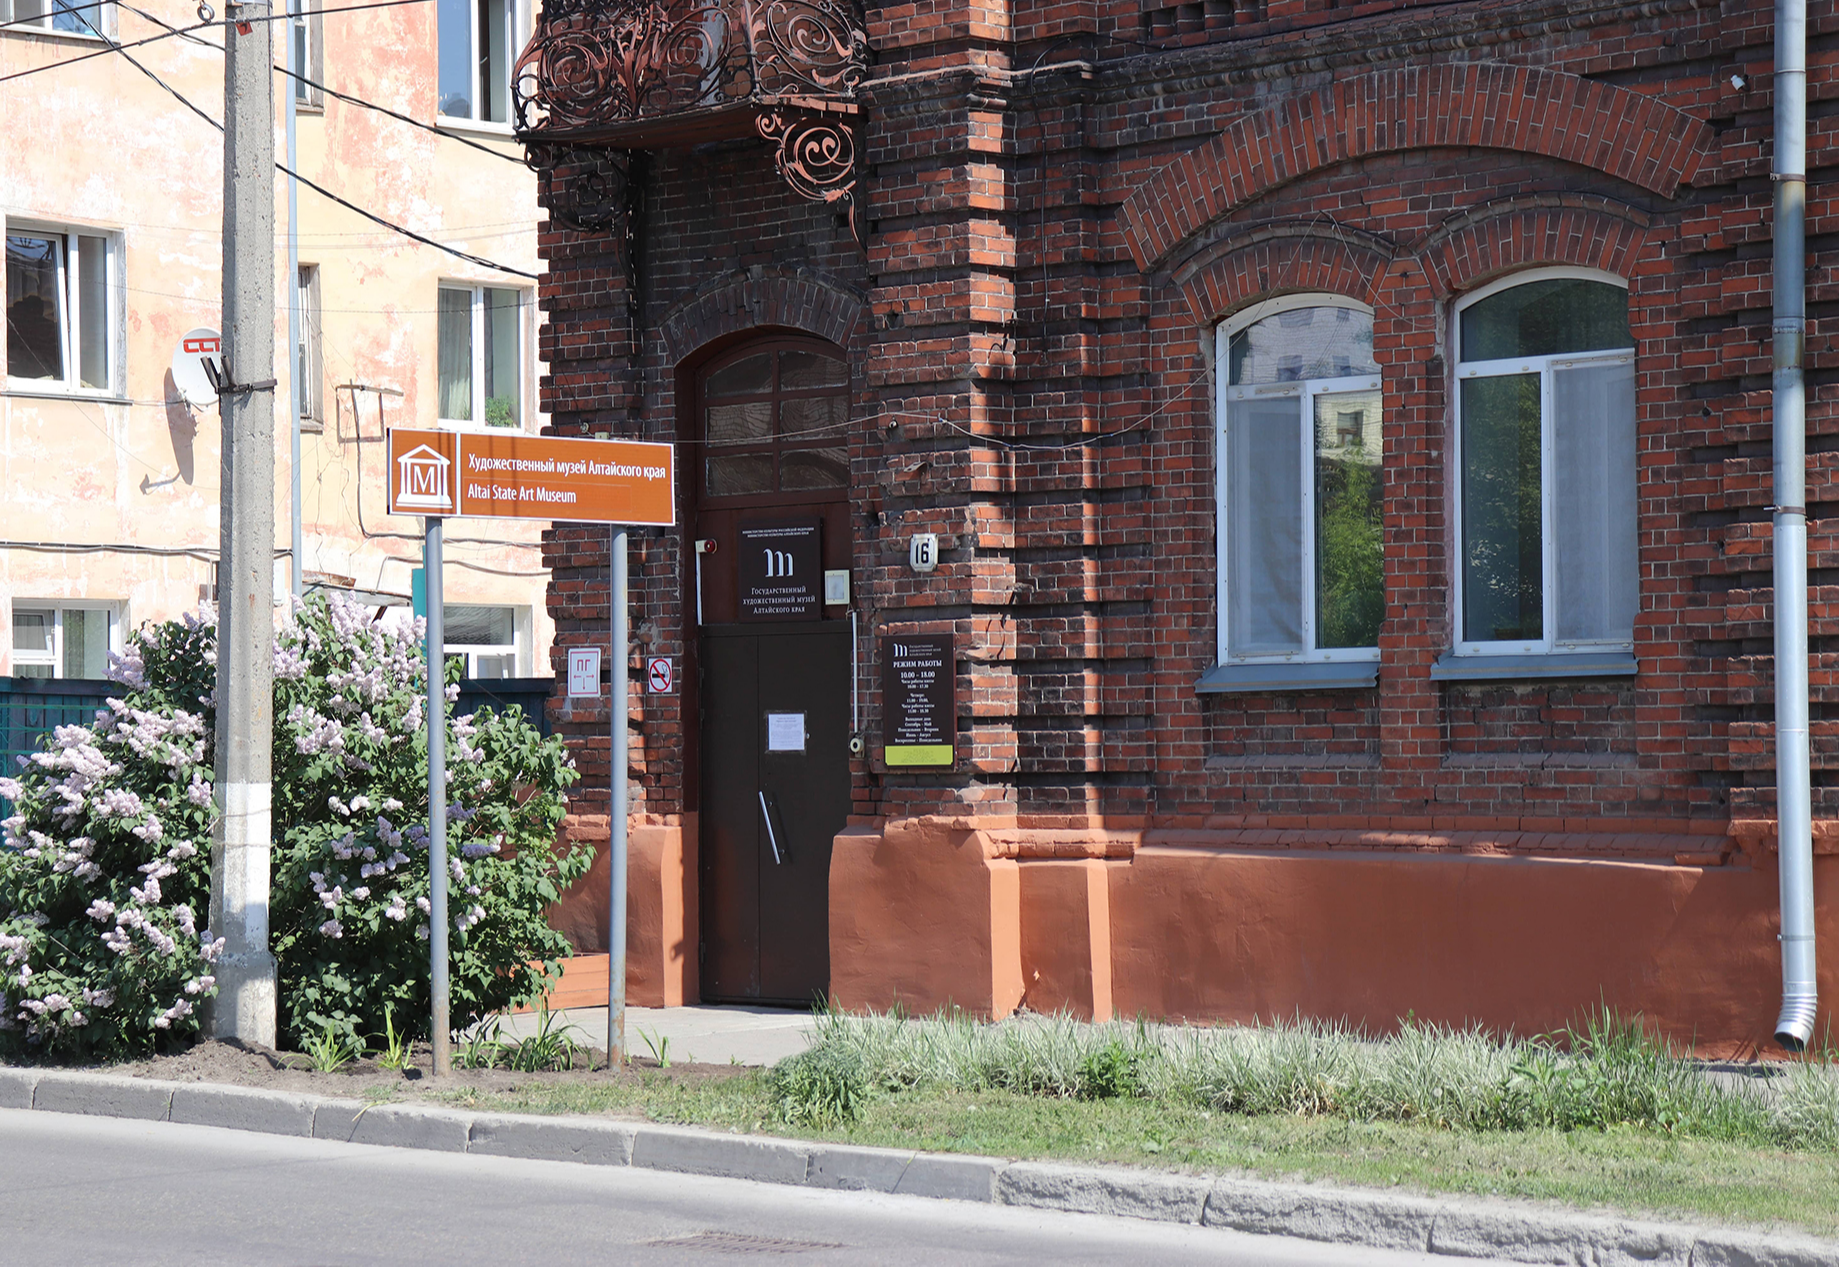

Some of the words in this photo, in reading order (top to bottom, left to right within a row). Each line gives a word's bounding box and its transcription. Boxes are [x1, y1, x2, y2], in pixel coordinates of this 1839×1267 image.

[468, 453, 554, 472] Художественный
[556, 459, 586, 477] музей
[588, 460, 642, 477] Алтайского
[643, 466, 666, 481] края
[467, 483, 490, 498] Altai
[492, 484, 517, 500] State
[518, 485, 534, 501] Art
[536, 486, 577, 503] Museum
[915, 542, 929, 564] 16
[577, 659, 591, 671] ПГ
